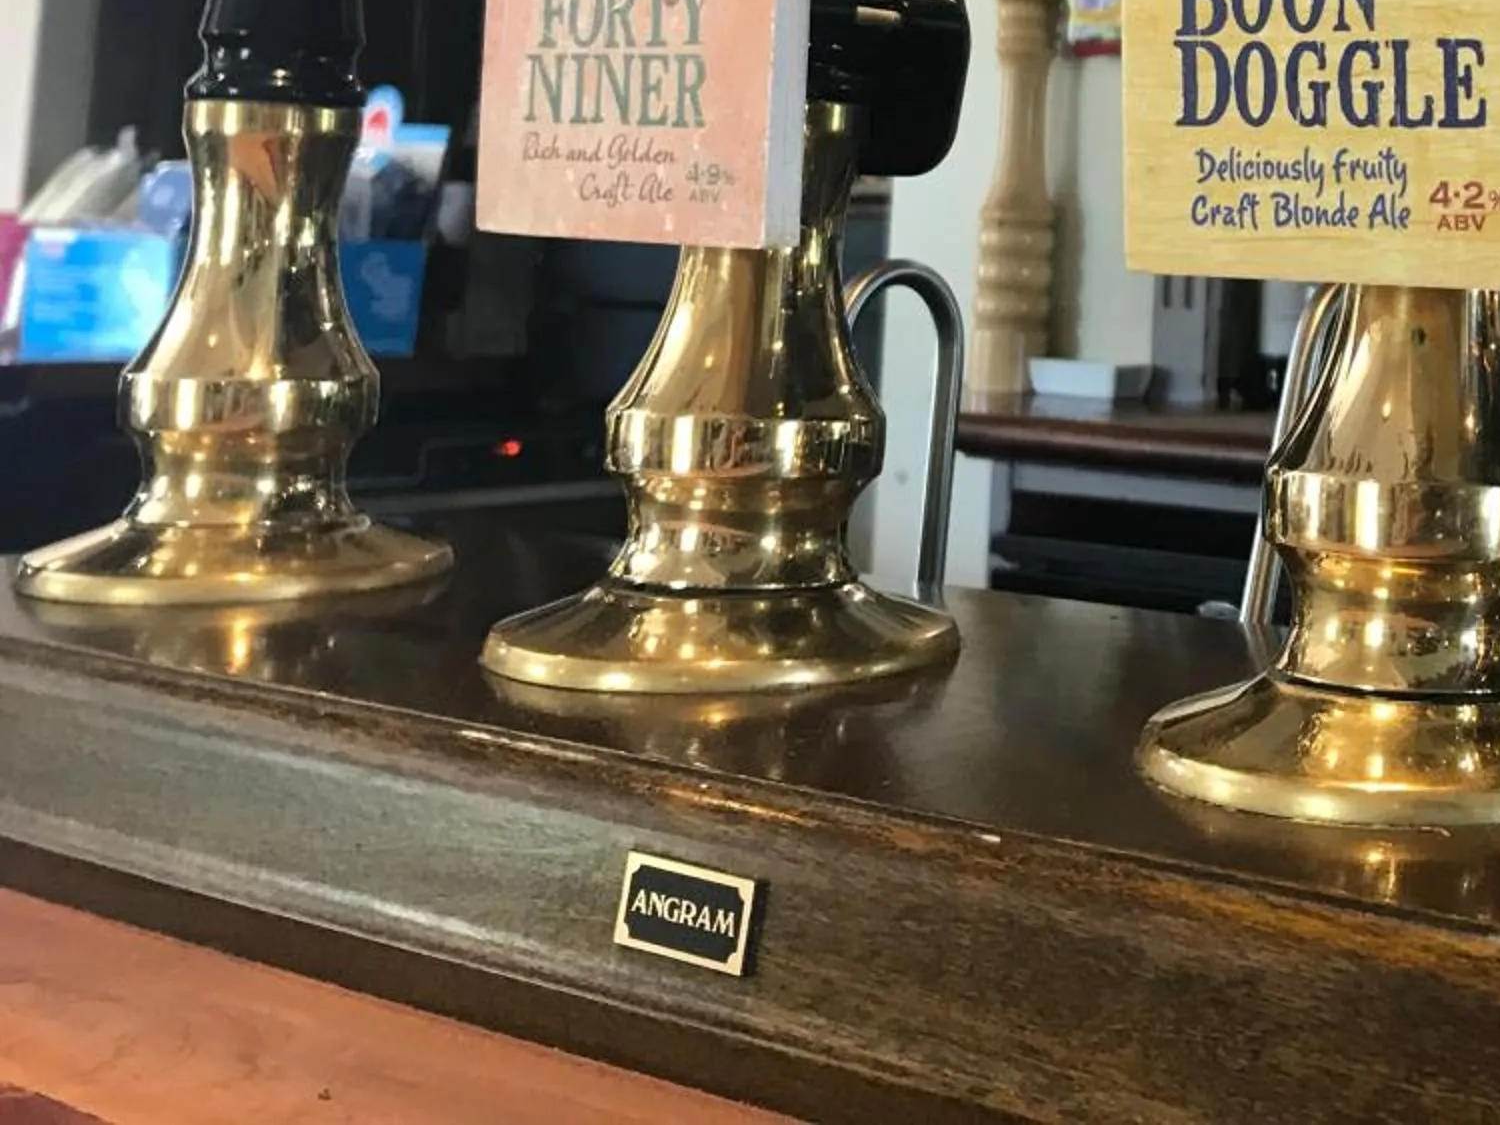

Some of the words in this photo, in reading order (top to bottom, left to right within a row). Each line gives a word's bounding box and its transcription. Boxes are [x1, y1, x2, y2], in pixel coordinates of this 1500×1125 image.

[523, 53, 707, 128] NINER
[1173, 38, 1487, 129] DOGGLE
[522, 131, 562, 162] Rich
[565, 138, 603, 164] and
[607, 132, 675, 170] Golden
[1195, 145, 1325, 198] Deliciously
[1332, 145, 1408, 198] fruity
[579, 170, 636, 209] Craft
[639, 171, 674, 204] Ale
[688, 188, 723, 204] ABV
[1190, 192, 1260, 232] Craft
[1270, 189, 1360, 229] Blonde
[1367, 192, 1412, 231] Ale
[1436, 213, 1487, 232] ABV
[630, 888, 735, 938] ANGRAM
